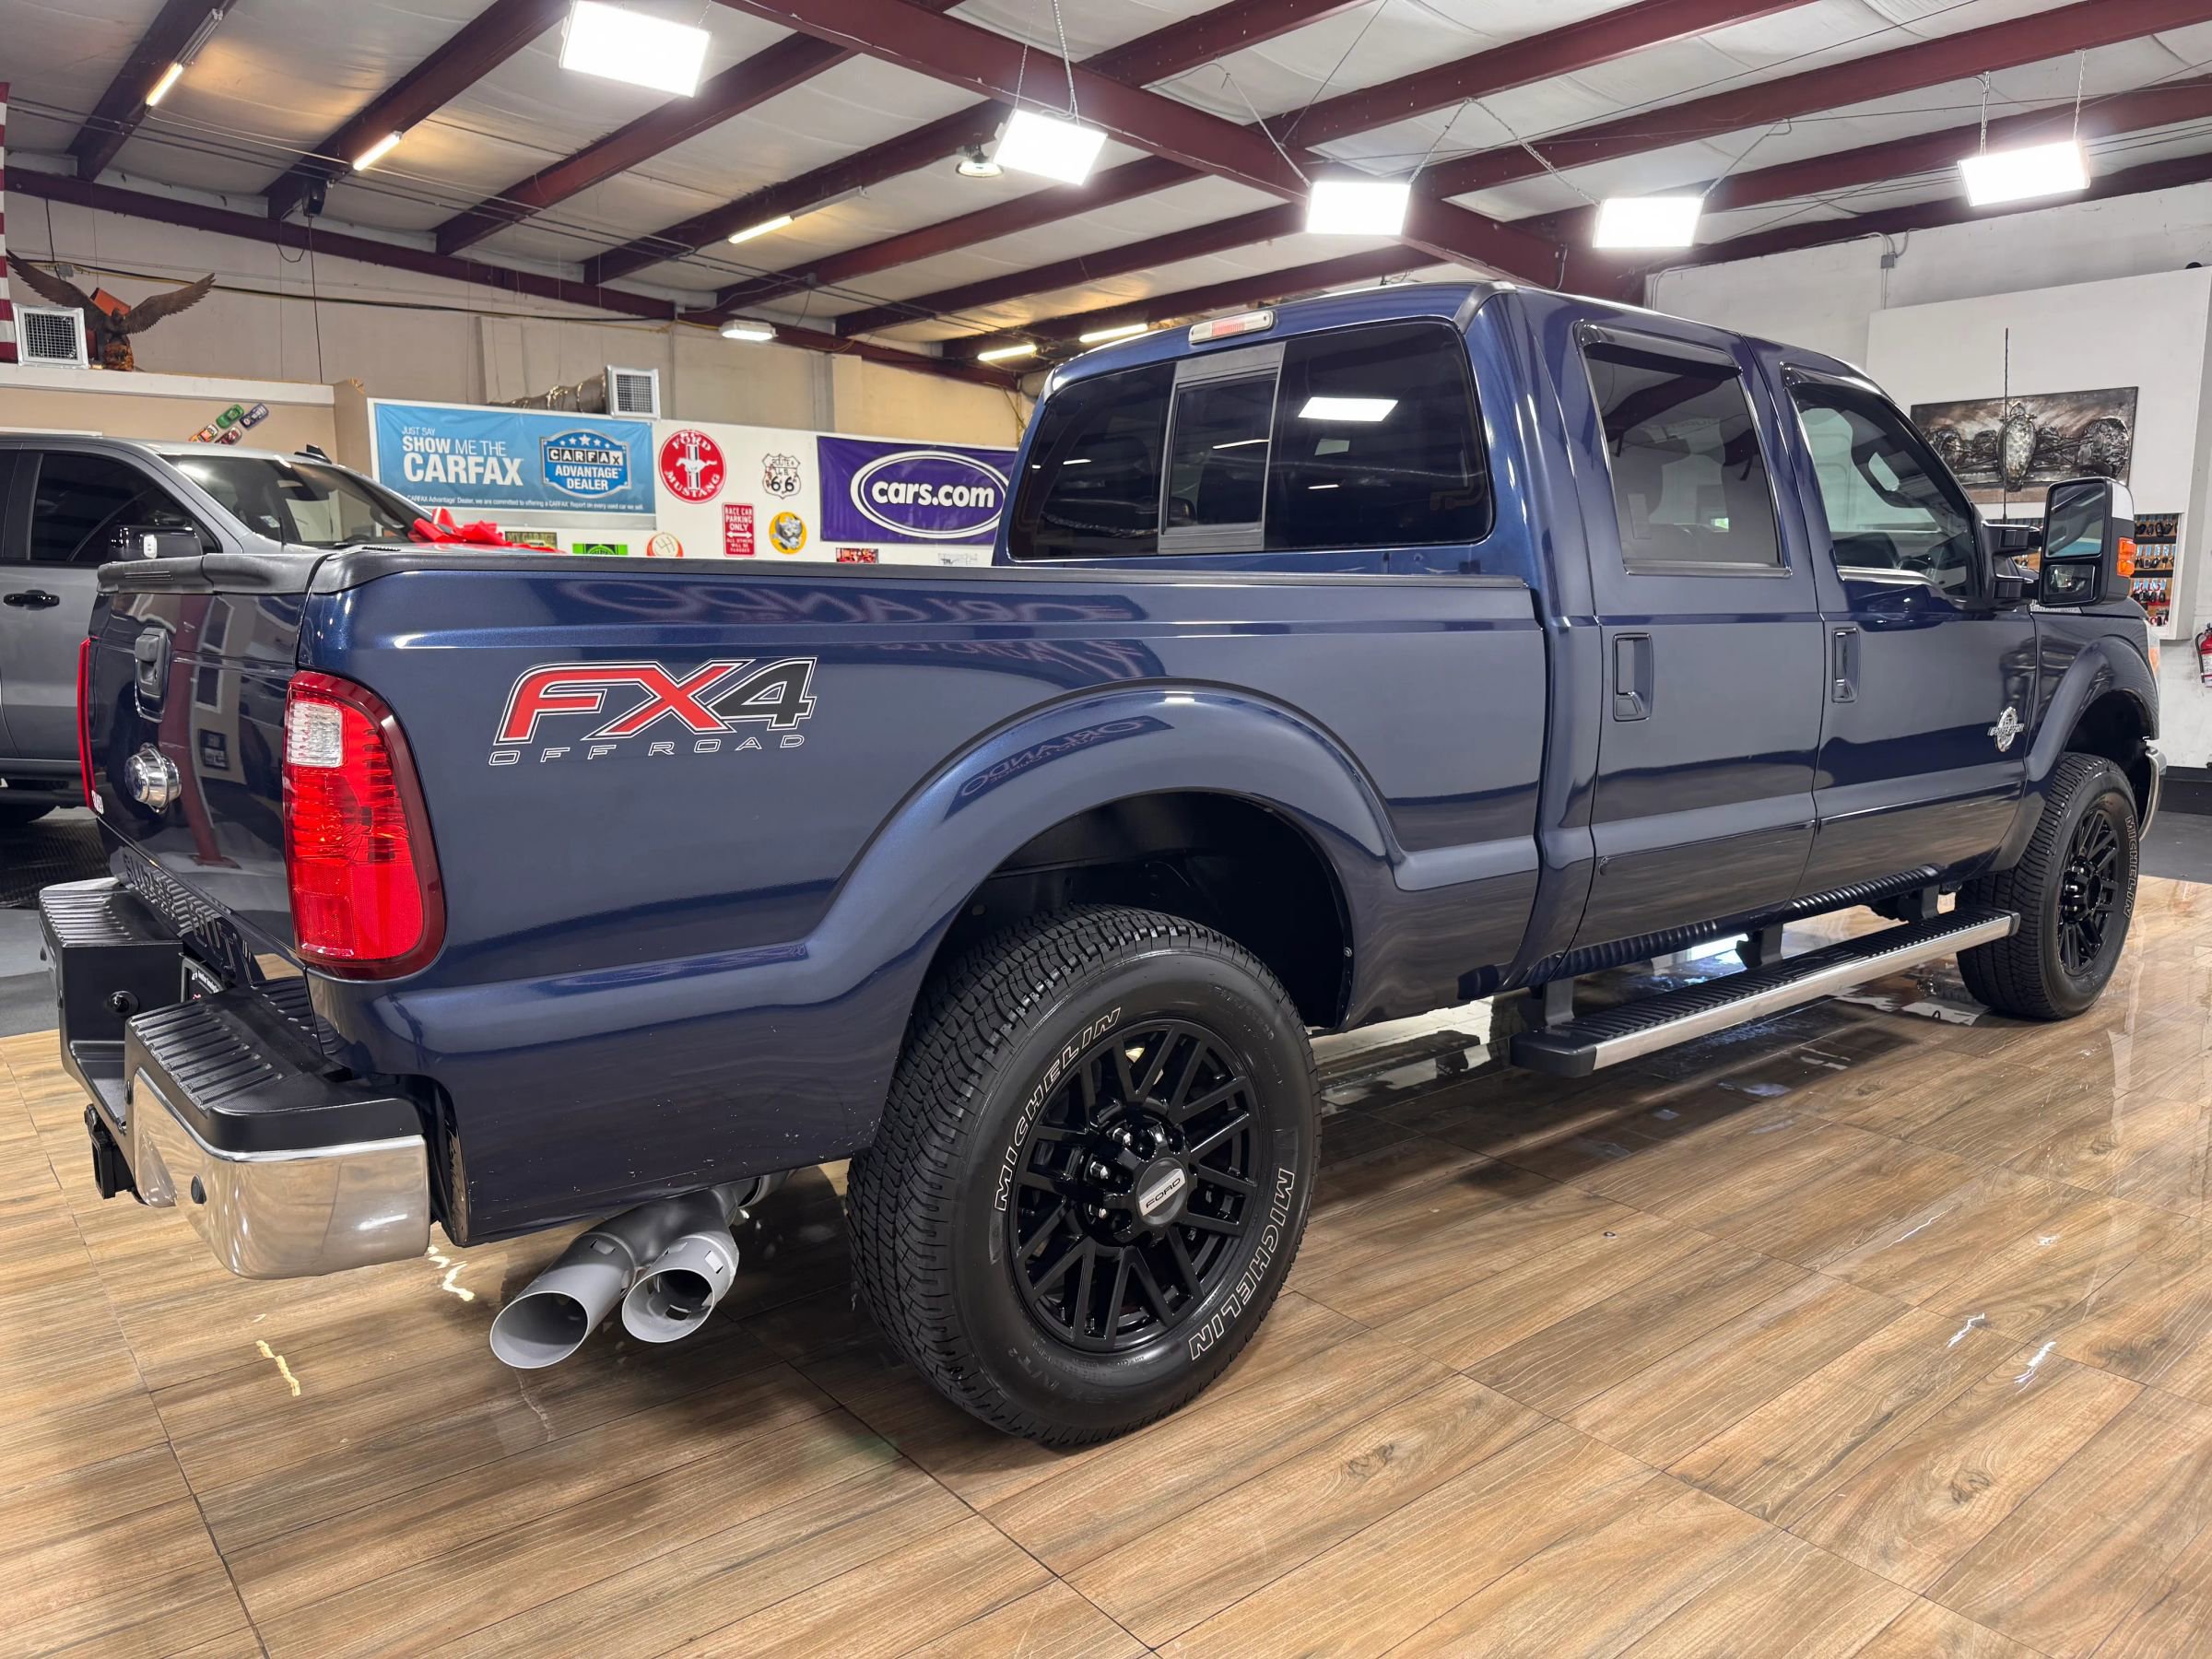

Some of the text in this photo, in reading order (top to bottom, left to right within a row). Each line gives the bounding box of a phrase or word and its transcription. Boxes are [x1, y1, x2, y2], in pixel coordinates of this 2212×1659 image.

[401, 427, 436, 436] JUST SAY
[672, 436, 712, 452] FORD
[402, 436, 507, 457] SHOW ME THE
[549, 449, 622, 465] CARFAX
[403, 452, 524, 487] CARFAX
[555, 465, 619, 479] ADVANTAGE
[566, 477, 609, 491] DEALER
[664, 470, 721, 498] MUSTANG
[871, 480, 995, 508] cars.com
[725, 515, 752, 524] PARKING
[729, 523, 749, 532] ONLY
[493, 656, 818, 746] FX4
[488, 735, 805, 766] OFF ROAD
[2123, 815, 2138, 919] MICHELIN
[994, 1006, 1121, 1211] MICHELIN
[1146, 1178, 1181, 1208] FORD
[1188, 1168, 1295, 1360] MICHELIN
